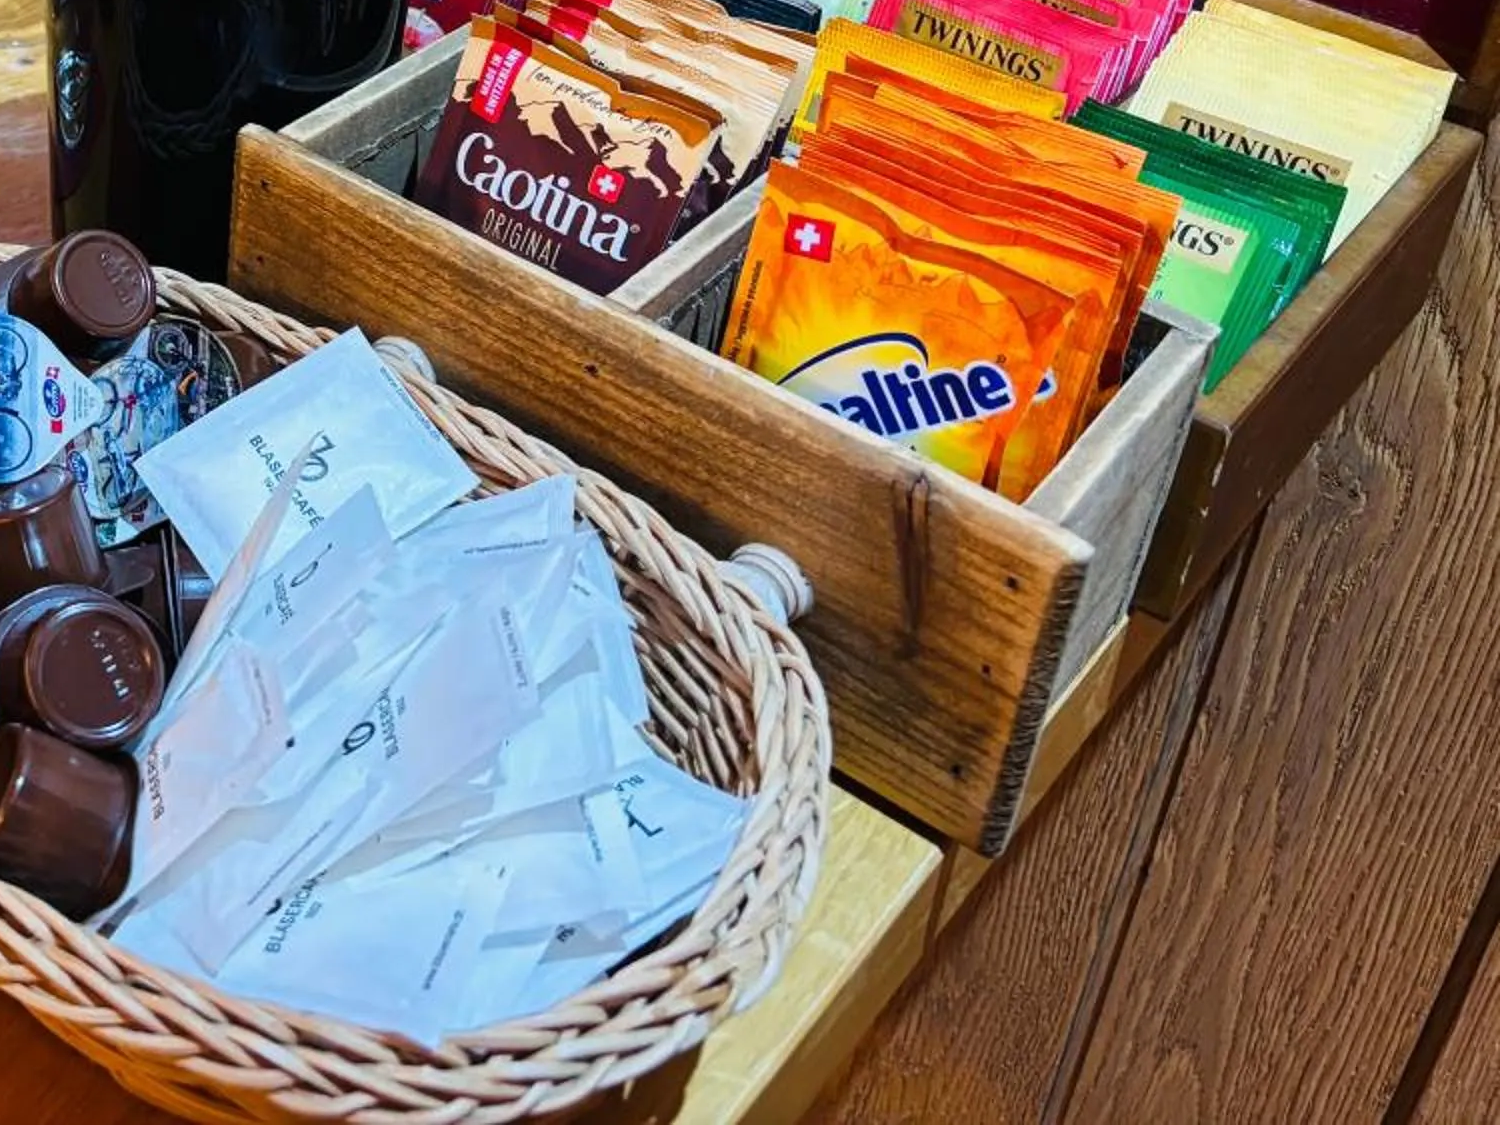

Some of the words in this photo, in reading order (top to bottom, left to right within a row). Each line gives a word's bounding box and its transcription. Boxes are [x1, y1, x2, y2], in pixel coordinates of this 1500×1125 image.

[912, 9, 1045, 83] TWININGS
[455, 131, 629, 263] Caotina
[482, 206, 563, 272] ORIGINAL
